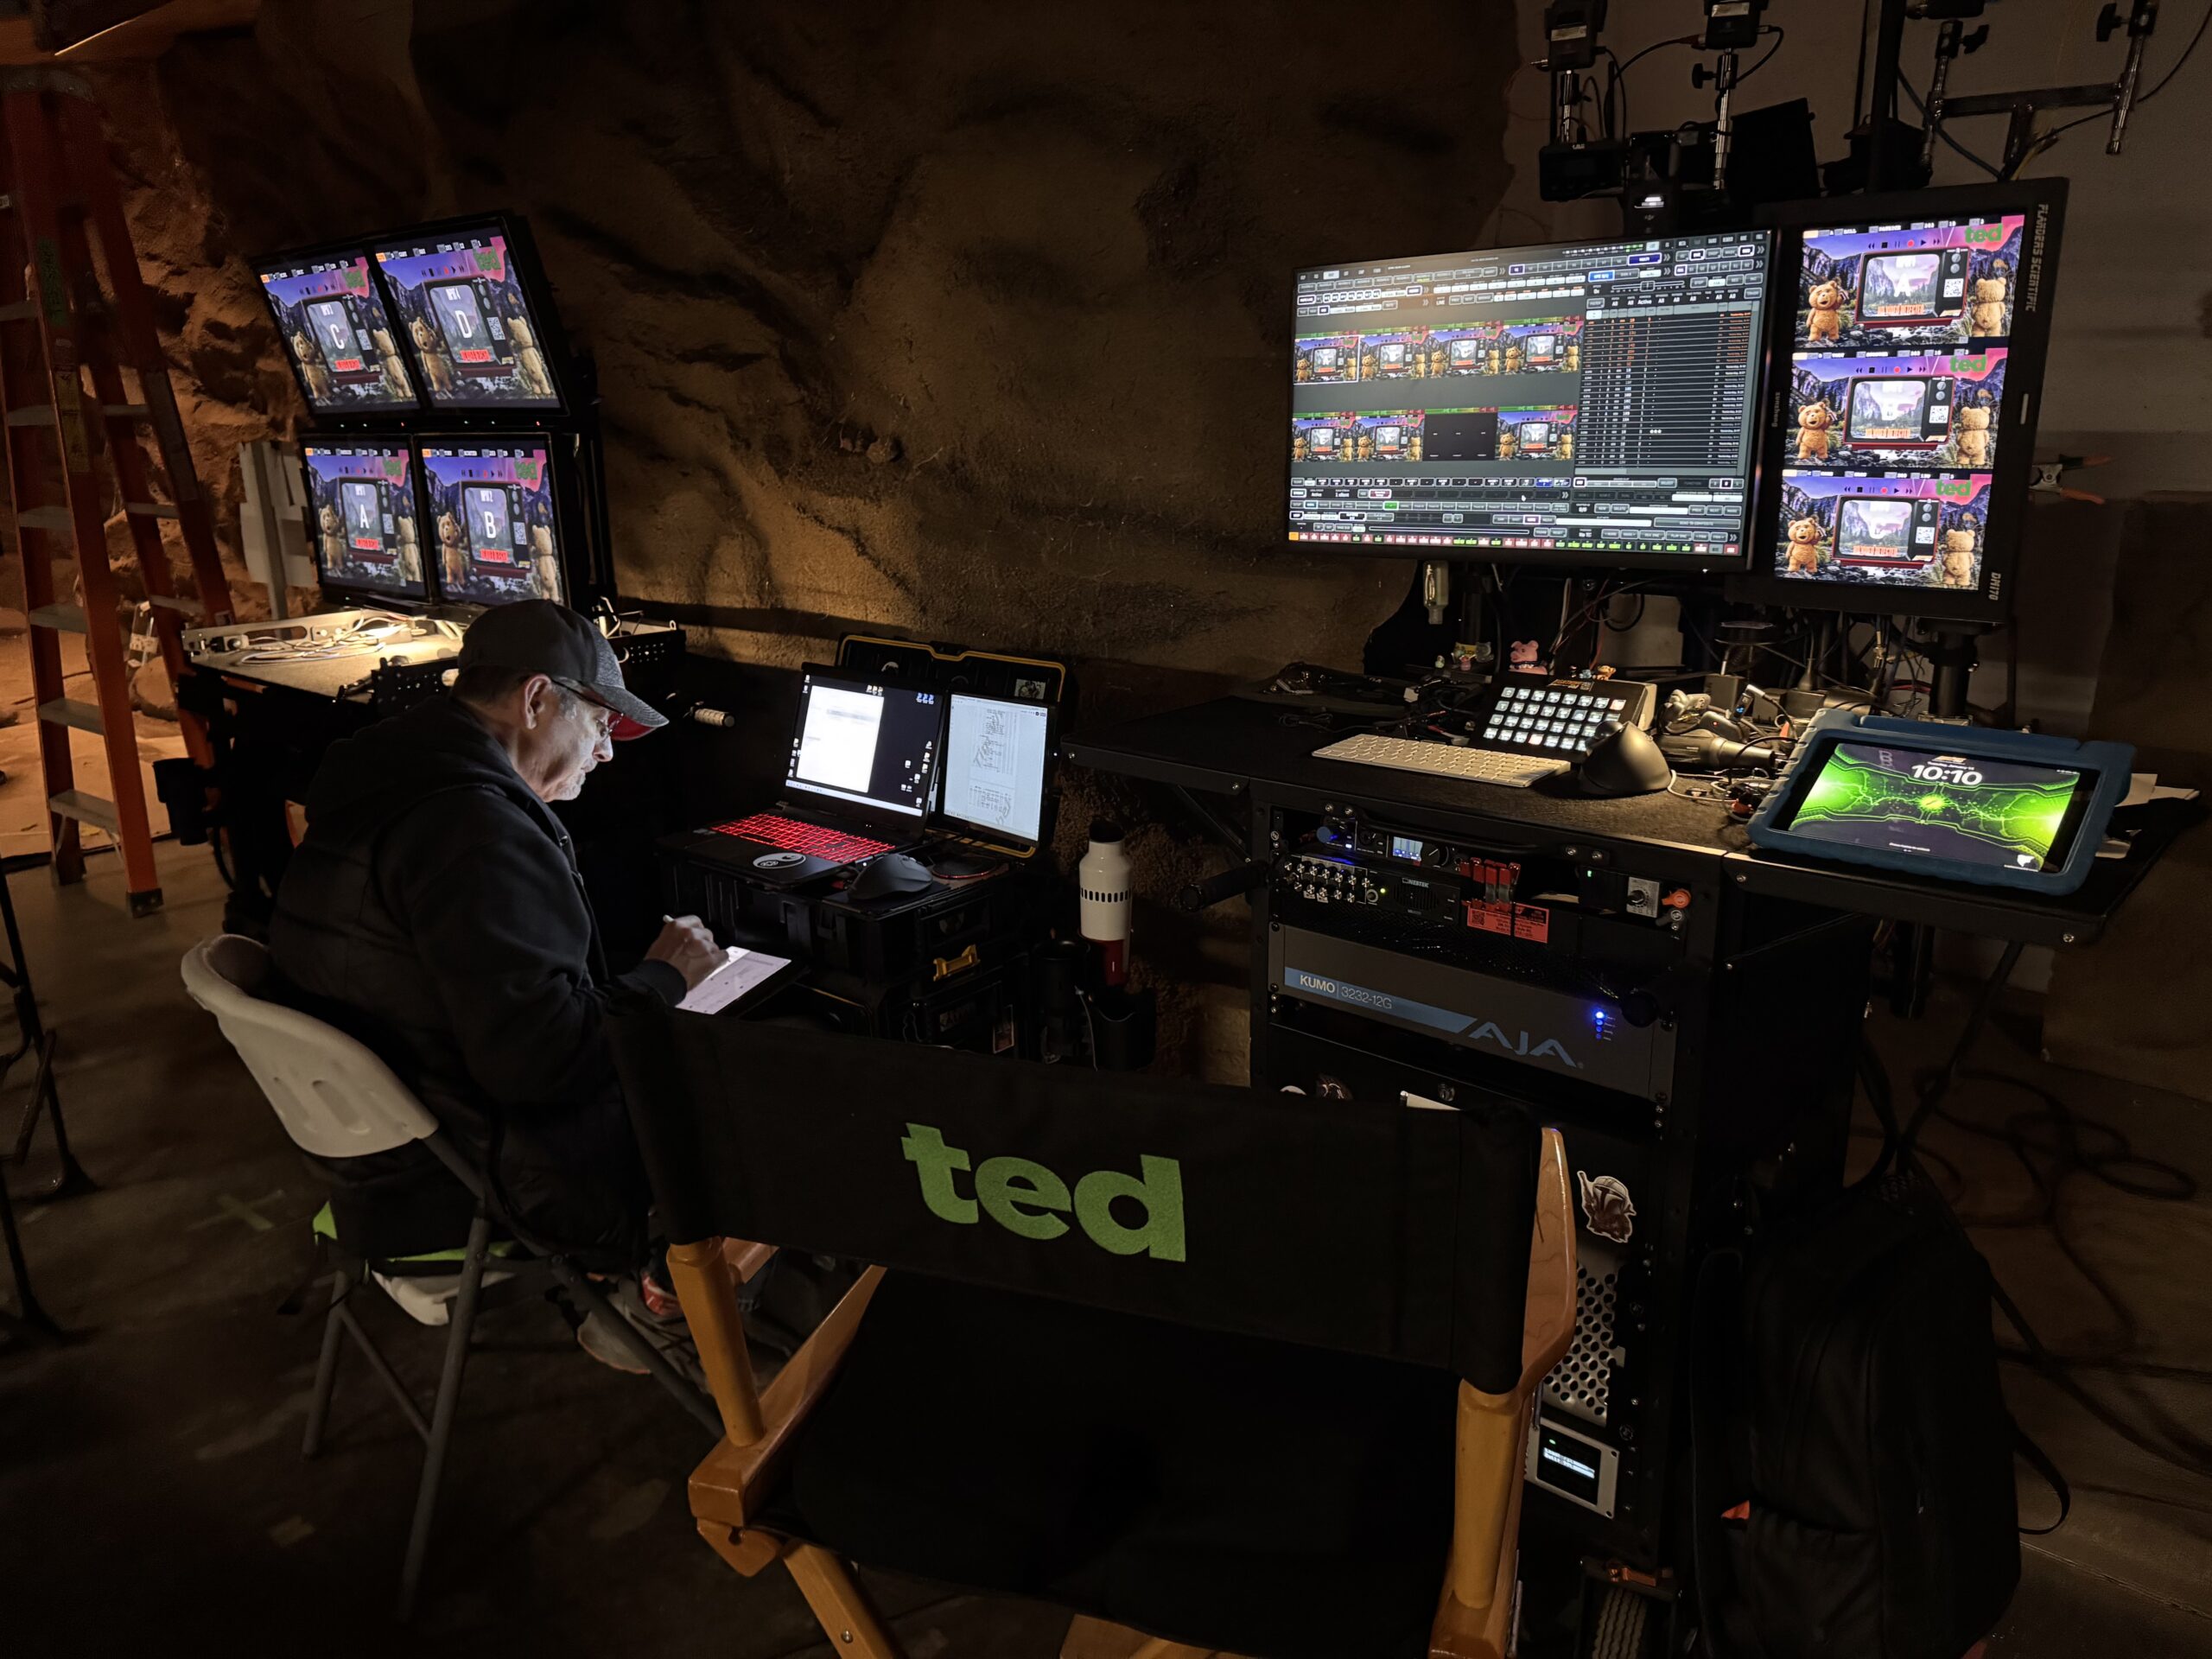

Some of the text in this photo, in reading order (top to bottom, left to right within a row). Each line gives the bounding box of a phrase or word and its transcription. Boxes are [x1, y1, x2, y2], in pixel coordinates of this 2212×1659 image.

[1965, 224, 2003, 243] ted
[2025, 204, 2049, 313] FLANDERS SCIENTIFIC
[330, 323, 346, 350] C
[454, 309, 472, 339] D
[1949, 355, 1987, 372] ted
[1936, 479, 1973, 497] ted
[359, 504, 369, 530] A
[484, 511, 496, 539] B
[1988, 571, 2002, 601] DM170
[1911, 765, 1983, 785] 10:10
[1300, 974, 1392, 1010] KUMO 3232-12G
[1469, 1020, 1578, 1069] AJA
[900, 1122, 1186, 1262] ted
